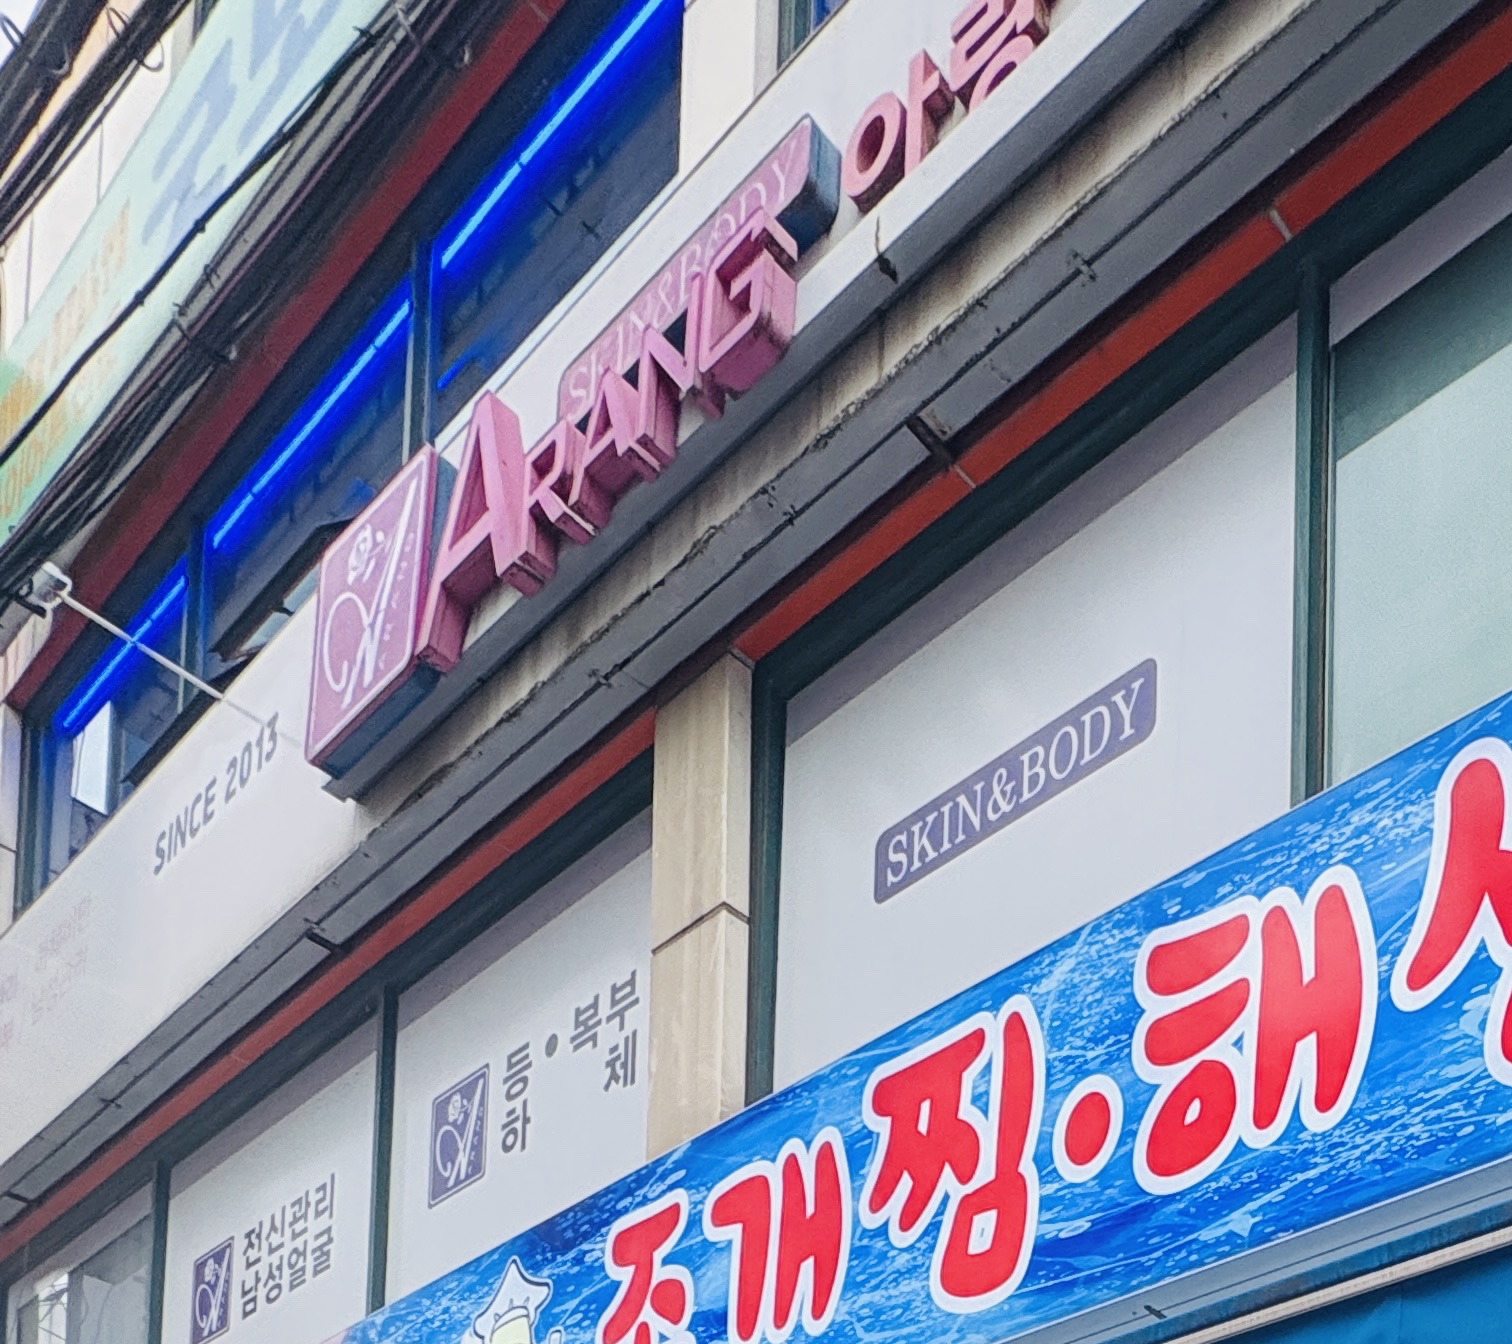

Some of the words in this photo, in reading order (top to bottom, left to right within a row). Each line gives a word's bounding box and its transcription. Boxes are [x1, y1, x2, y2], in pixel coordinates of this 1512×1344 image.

[415, 205, 800, 670] ARANG
[153, 775, 217, 876] SINCE
[224, 702, 279, 804] 2013
[886, 677, 1145, 886] SKIN&BODY
[240, 1225, 334, 1321] 남성얼굴
[243, 1173, 335, 1271] 전신관리
